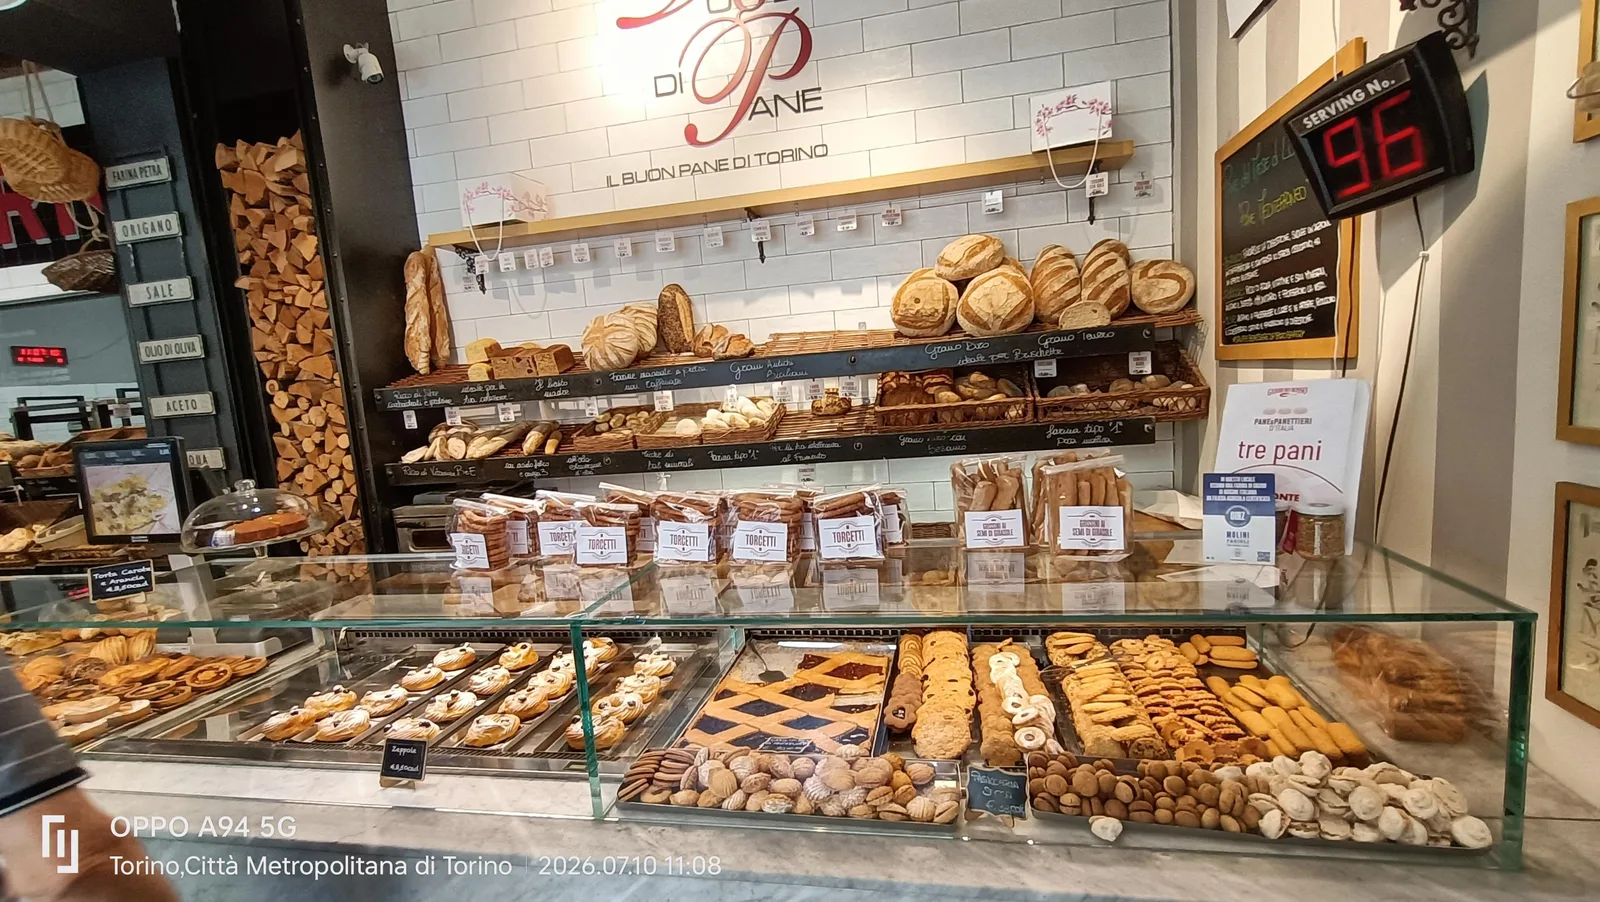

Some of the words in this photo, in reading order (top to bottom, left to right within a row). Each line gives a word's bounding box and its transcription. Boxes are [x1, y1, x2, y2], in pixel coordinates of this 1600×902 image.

[654, 72, 683, 98] DI
[1303, 89, 1366, 129] SERVING
[1366, 79, 1396, 95] No.
[1323, 90, 1425, 199] 96
[112, 168, 139, 182] FARINA
[139, 164, 162, 178] PETRA
[606, 174, 619, 188] IL
[622, 165, 675, 185] BUON
[680, 158, 729, 178] PANE
[733, 155, 750, 169] DI
[754, 143, 828, 166] TORINO
[122, 218, 172, 238] ORIGANO
[147, 283, 174, 300] SALE
[1037, 333, 1075, 349] Grano
[1077, 330, 1116, 341] Tenero
[145, 344, 163, 358] OLIO
[164, 344, 173, 355] DI
[174, 341, 197, 355] OLIVA
[924, 343, 962, 360] Grano
[962, 341, 990, 351] Duro
[988, 352, 1010, 363] per
[166, 399, 197, 412] ACETO
[1083, 423, 1105, 435] tipo
[1238, 441, 1266, 459] tre
[1273, 440, 1322, 465] pani
[670, 533, 699, 547] TORCETTI
[745, 533, 777, 548] TORCETTI
[832, 530, 865, 543] TORCETTI
[1226, 531, 1250, 539] MOLINI
[588, 538, 617, 550] TORCETTI
[93, 571, 118, 580] Torta
[109, 575, 145, 585] Arancia
